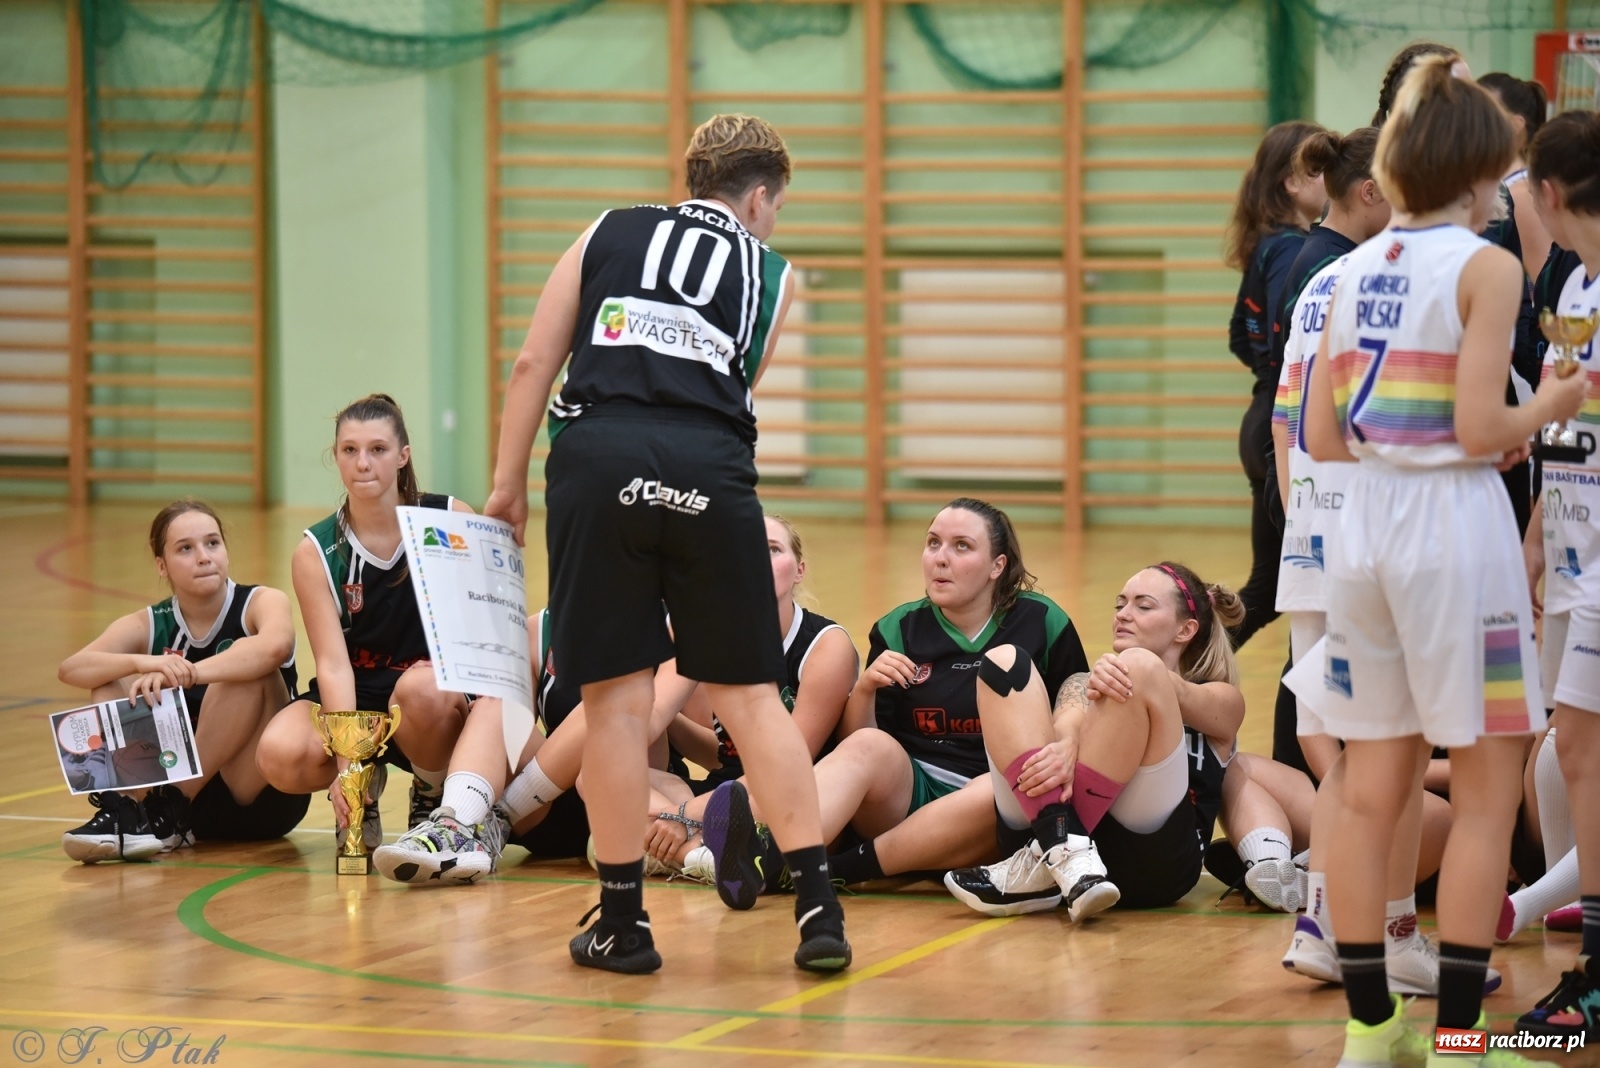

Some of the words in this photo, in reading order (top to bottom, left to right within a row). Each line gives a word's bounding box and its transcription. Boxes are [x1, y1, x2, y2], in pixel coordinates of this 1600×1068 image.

[641, 219, 733, 307] 10
[628, 318, 729, 362] WAGTECH
[1346, 337, 1387, 444] 7
[643, 480, 710, 511] Clavis
[492, 548, 505, 568] 5
[467, 590, 517, 609] Raciborski
[69, 714, 84, 751] DYPLOM
